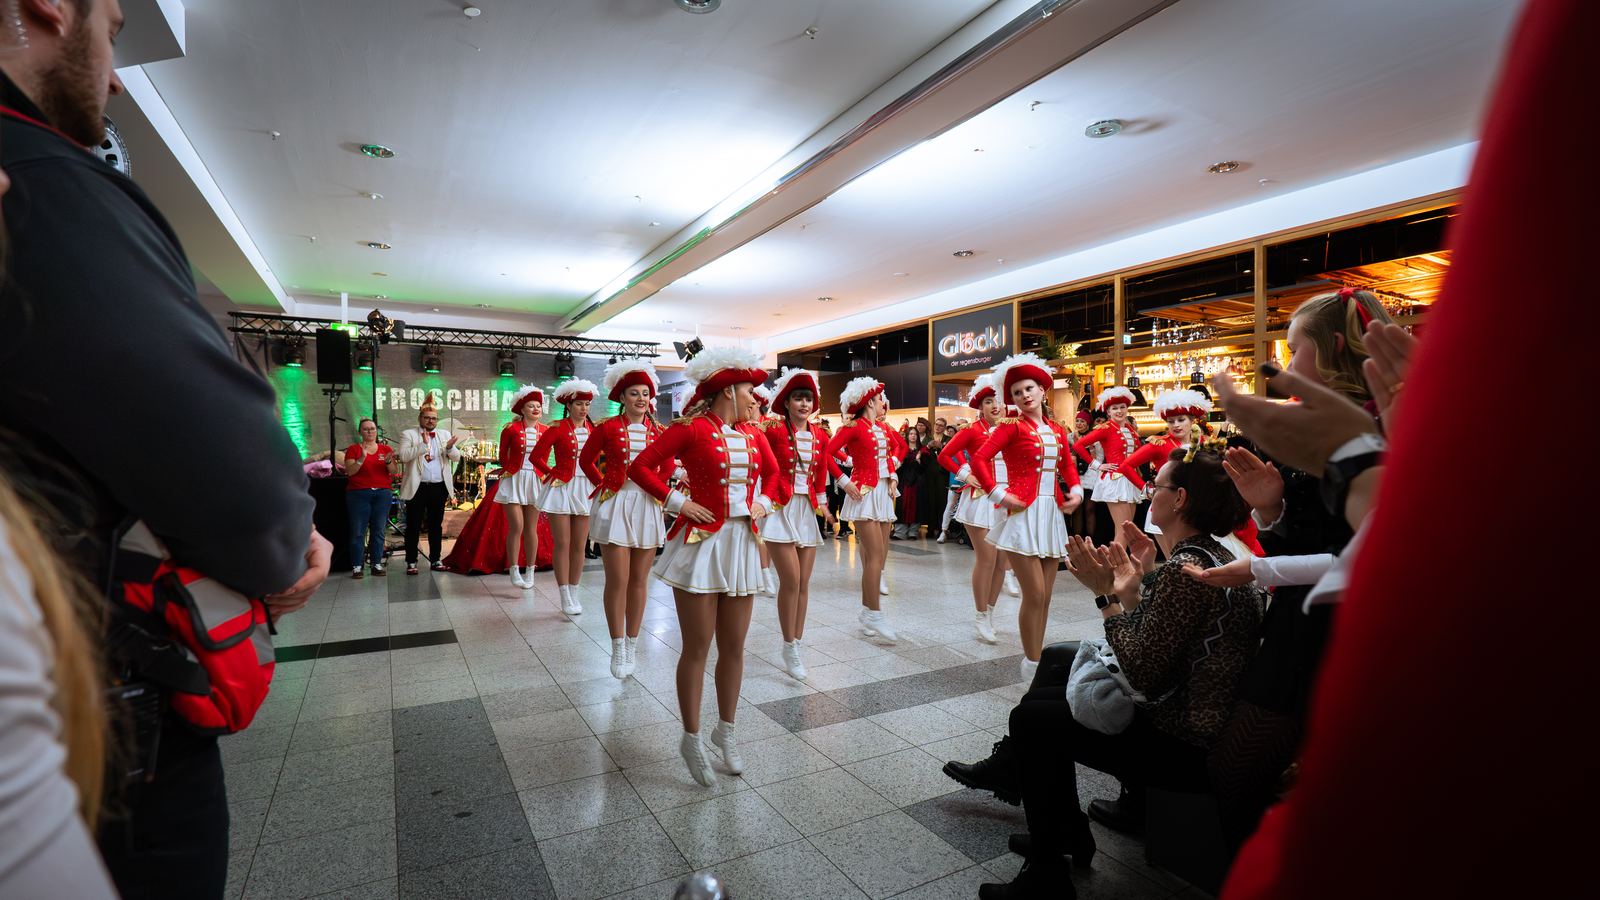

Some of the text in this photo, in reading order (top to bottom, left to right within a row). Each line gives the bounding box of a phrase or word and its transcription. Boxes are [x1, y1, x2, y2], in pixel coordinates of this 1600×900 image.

[938, 323, 1007, 358] Glöckl
[960, 356, 992, 366] regensburger
[375, 387, 550, 414] FROSCHHA
